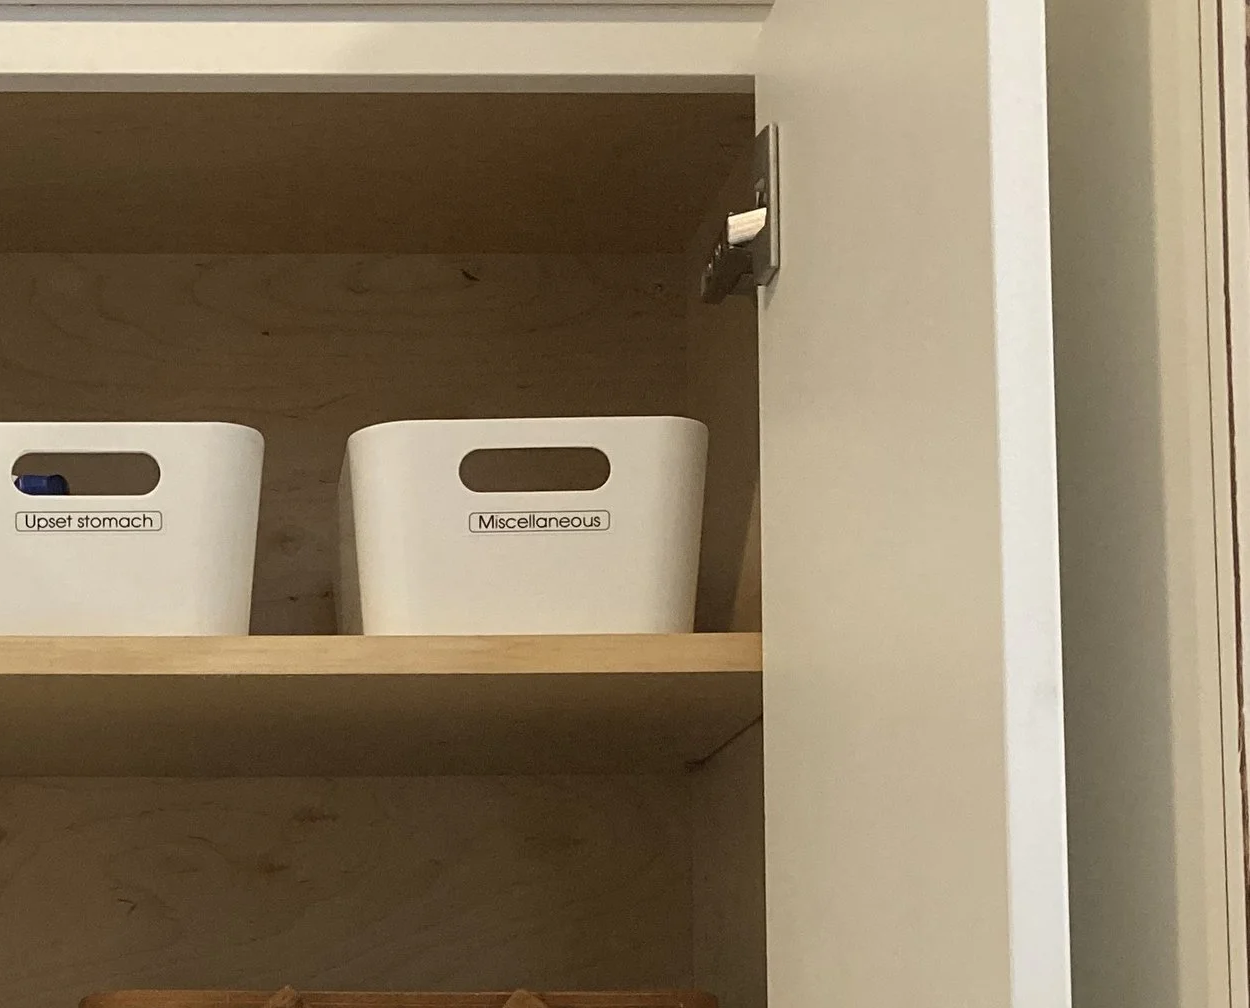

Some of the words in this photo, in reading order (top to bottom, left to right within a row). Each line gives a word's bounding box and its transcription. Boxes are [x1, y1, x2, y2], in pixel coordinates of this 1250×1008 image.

[25, 514, 72, 530] Upset
[77, 513, 153, 529] stomach
[478, 514, 601, 530] Miscellaneous
